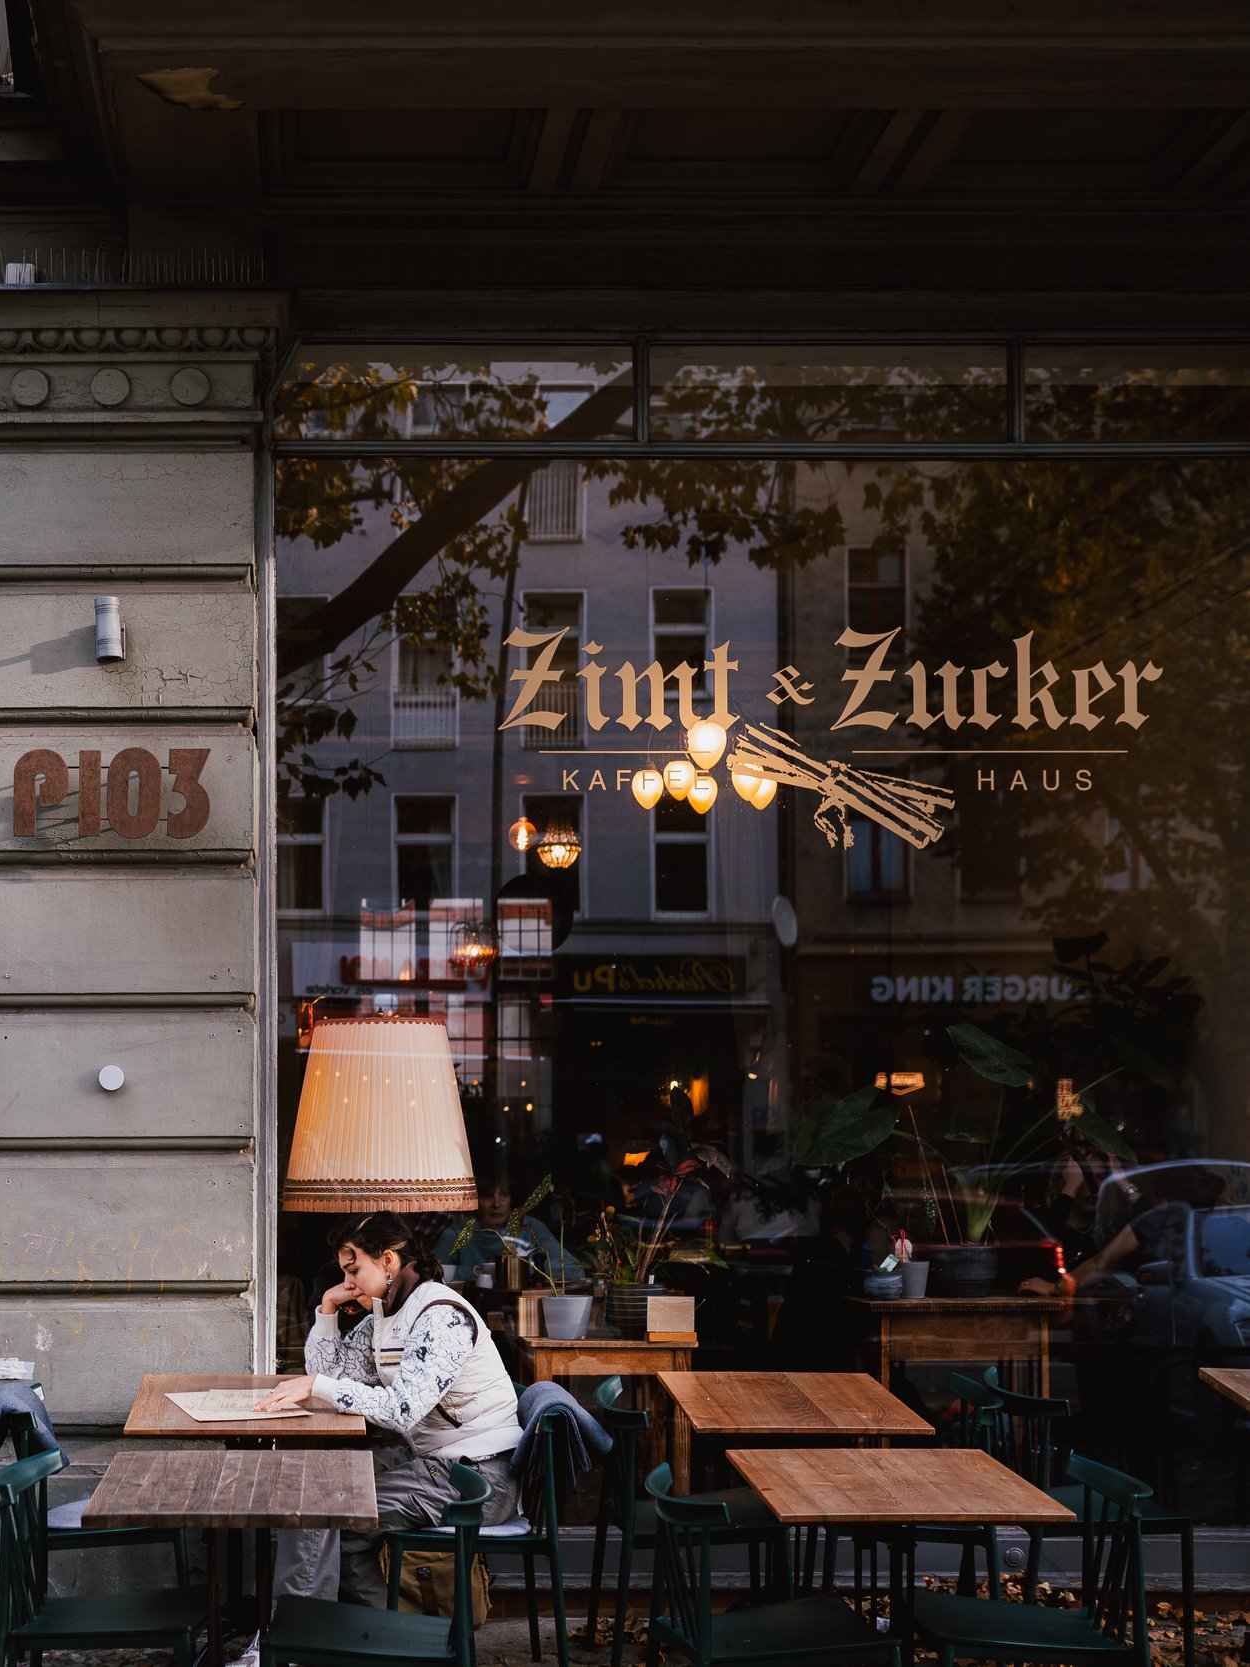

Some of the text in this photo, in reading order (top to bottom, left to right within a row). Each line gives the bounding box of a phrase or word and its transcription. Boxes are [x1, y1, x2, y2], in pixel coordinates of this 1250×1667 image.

[498, 625, 1163, 732] Zimt & Zucker
[12, 746, 212, 839] P103
[562, 769, 1094, 791] KAFFEE HAUS
